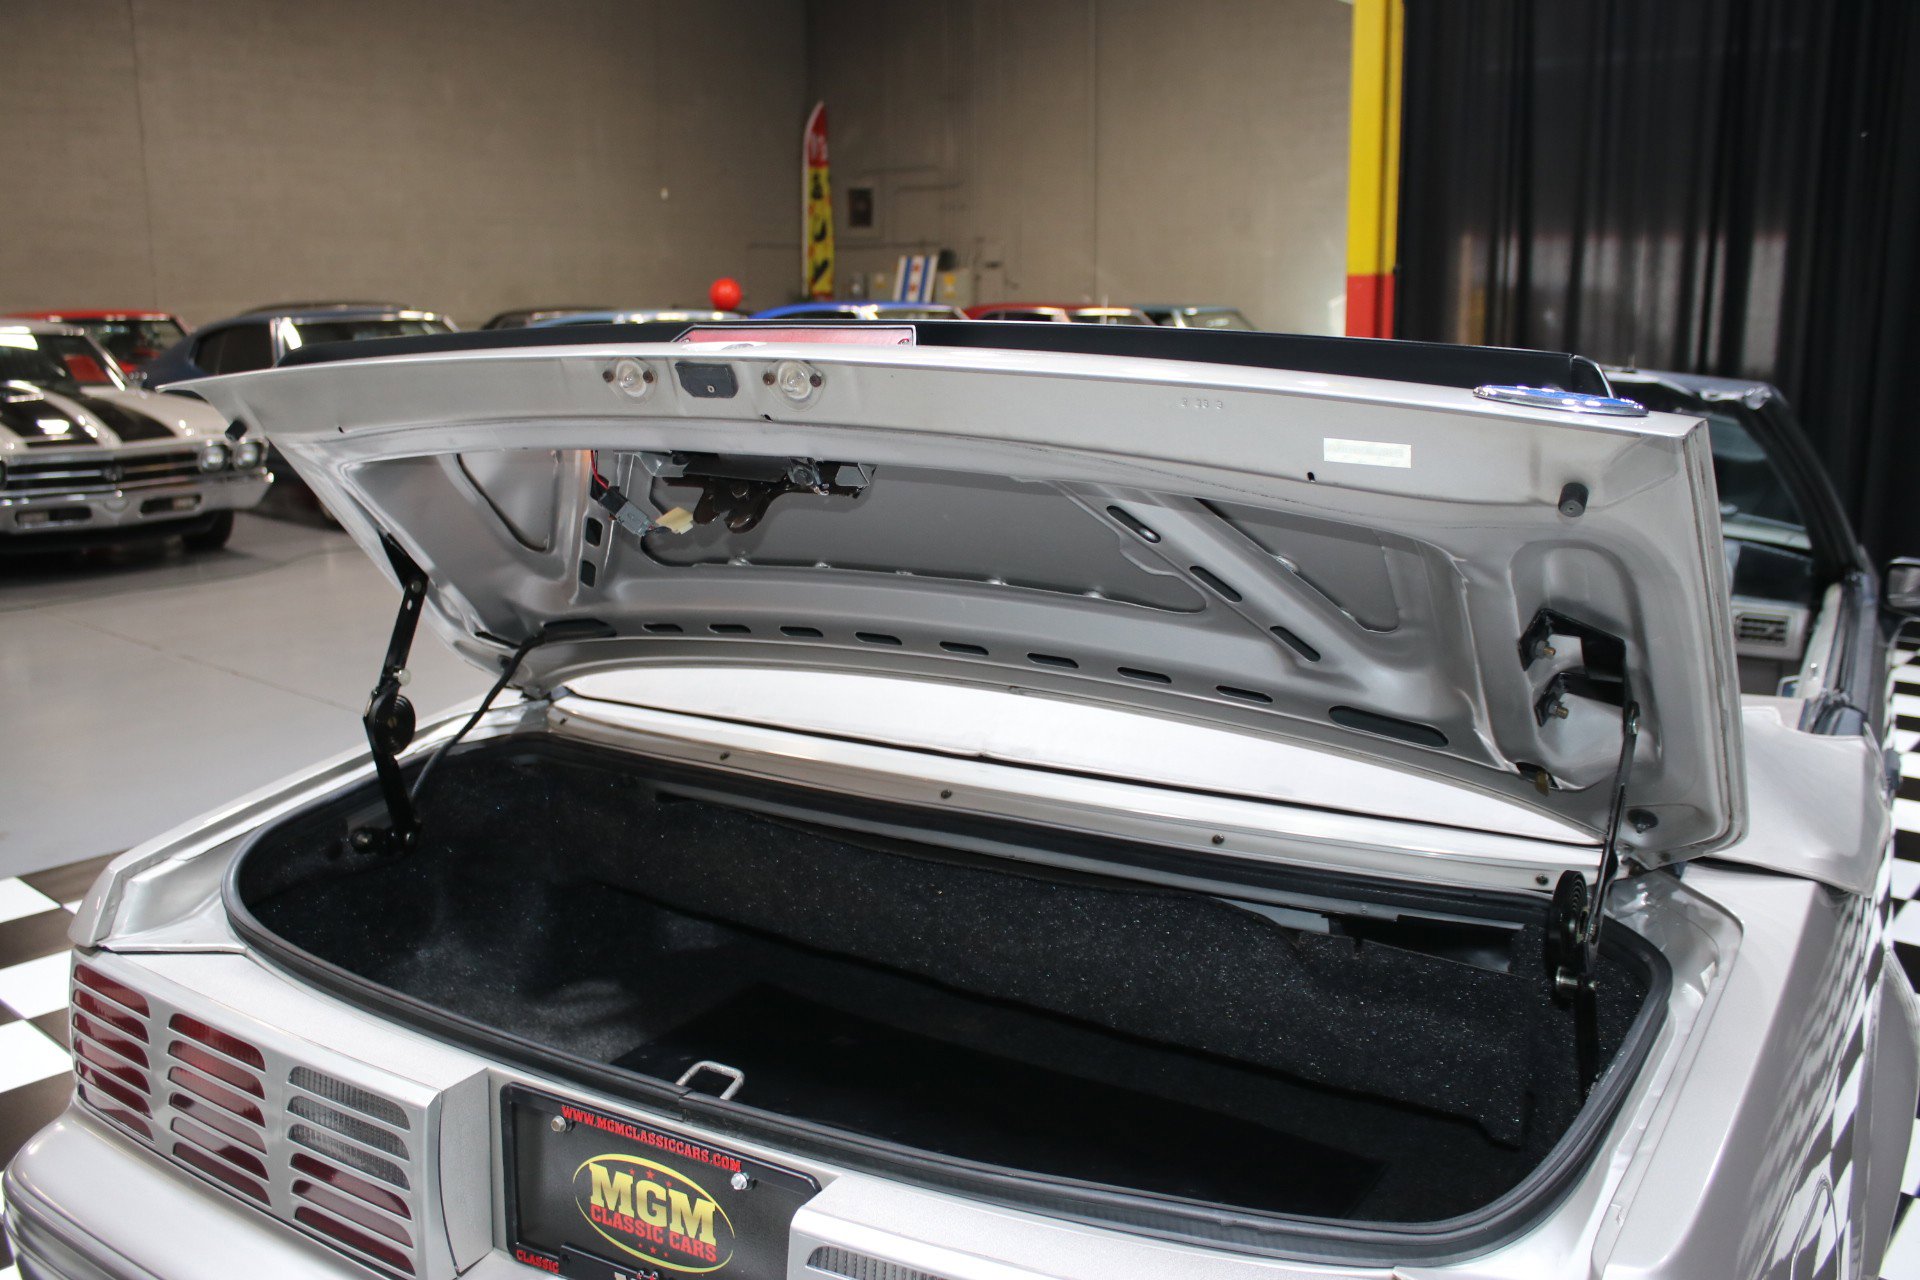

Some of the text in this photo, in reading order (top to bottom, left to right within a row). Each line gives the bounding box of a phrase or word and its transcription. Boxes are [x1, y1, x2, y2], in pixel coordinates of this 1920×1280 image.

[561, 1105, 742, 1173] WWW.MGMCLASSICCARS.COM
[588, 1162, 717, 1247] MGM
[590, 1204, 717, 1263] CLASSIC CARS
[516, 1249, 560, 1274] CLASSIC
